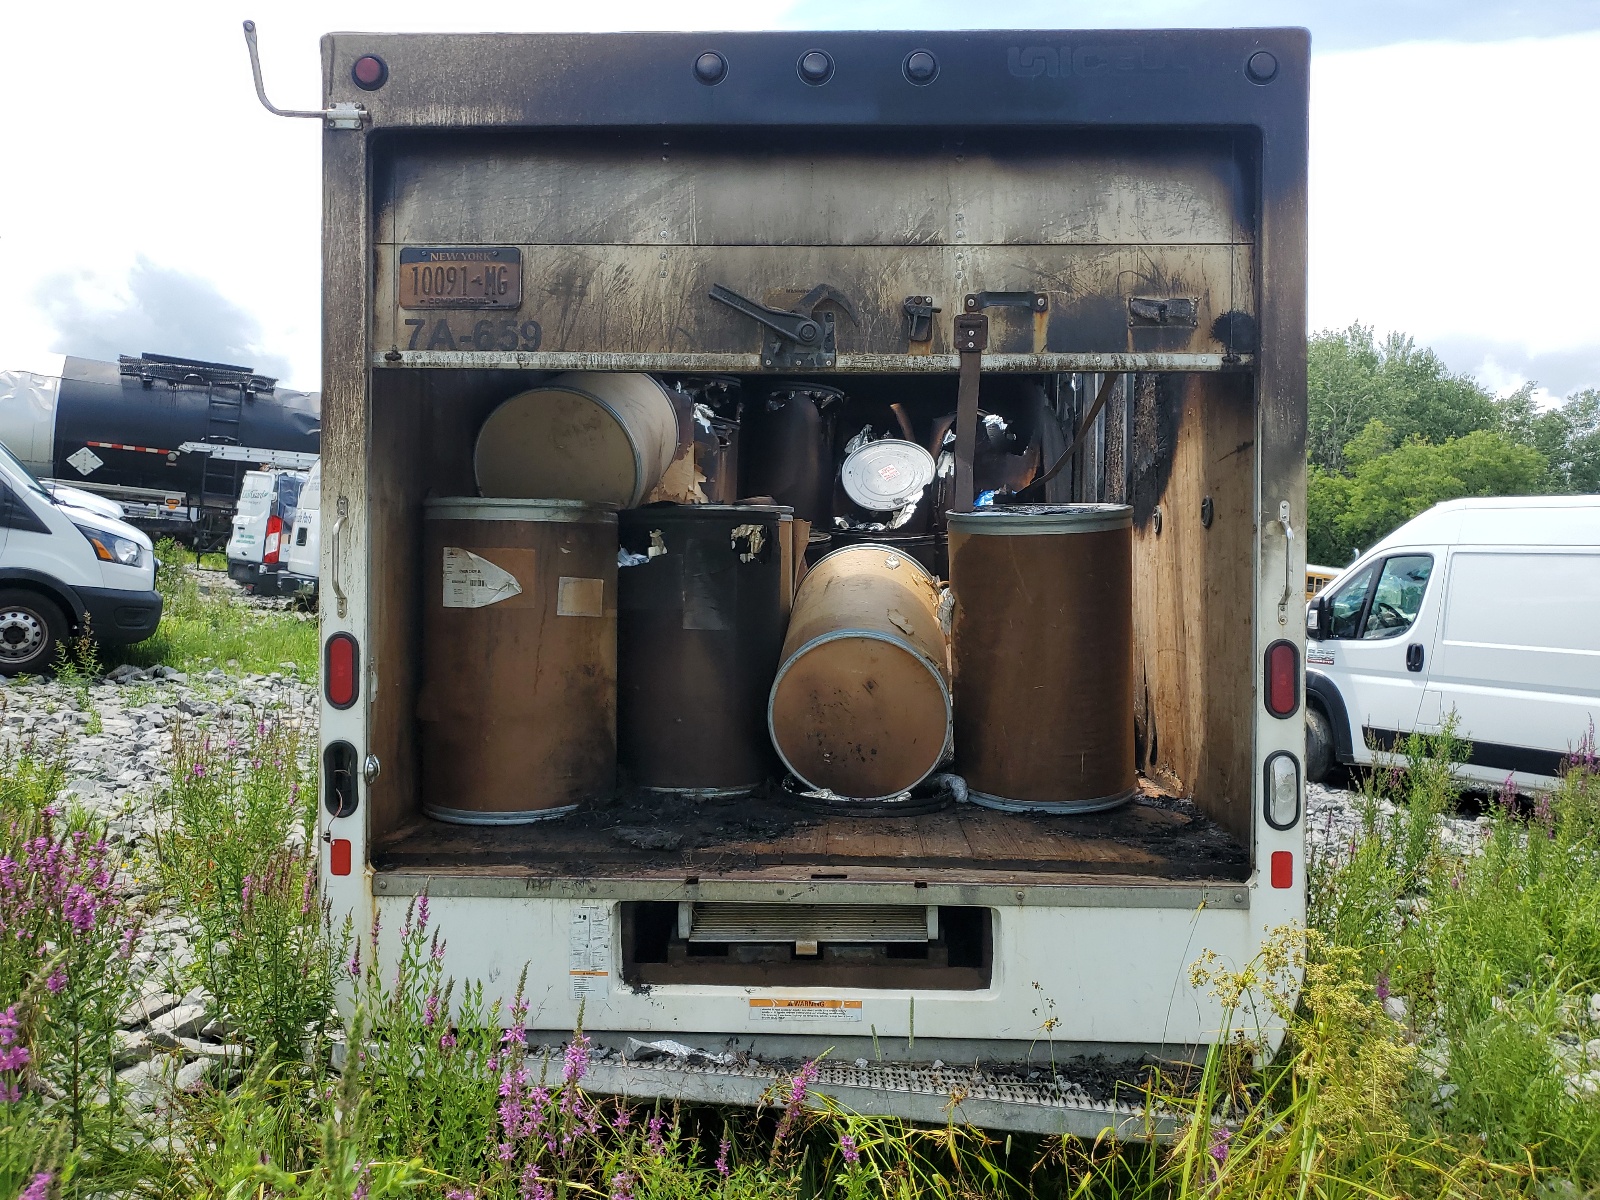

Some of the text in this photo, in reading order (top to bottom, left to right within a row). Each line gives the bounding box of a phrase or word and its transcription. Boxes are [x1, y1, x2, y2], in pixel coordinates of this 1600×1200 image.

[430, 252, 492, 261] NEW YORK
[411, 266, 467, 296] 10091
[405, 318, 542, 351] 7A-659
